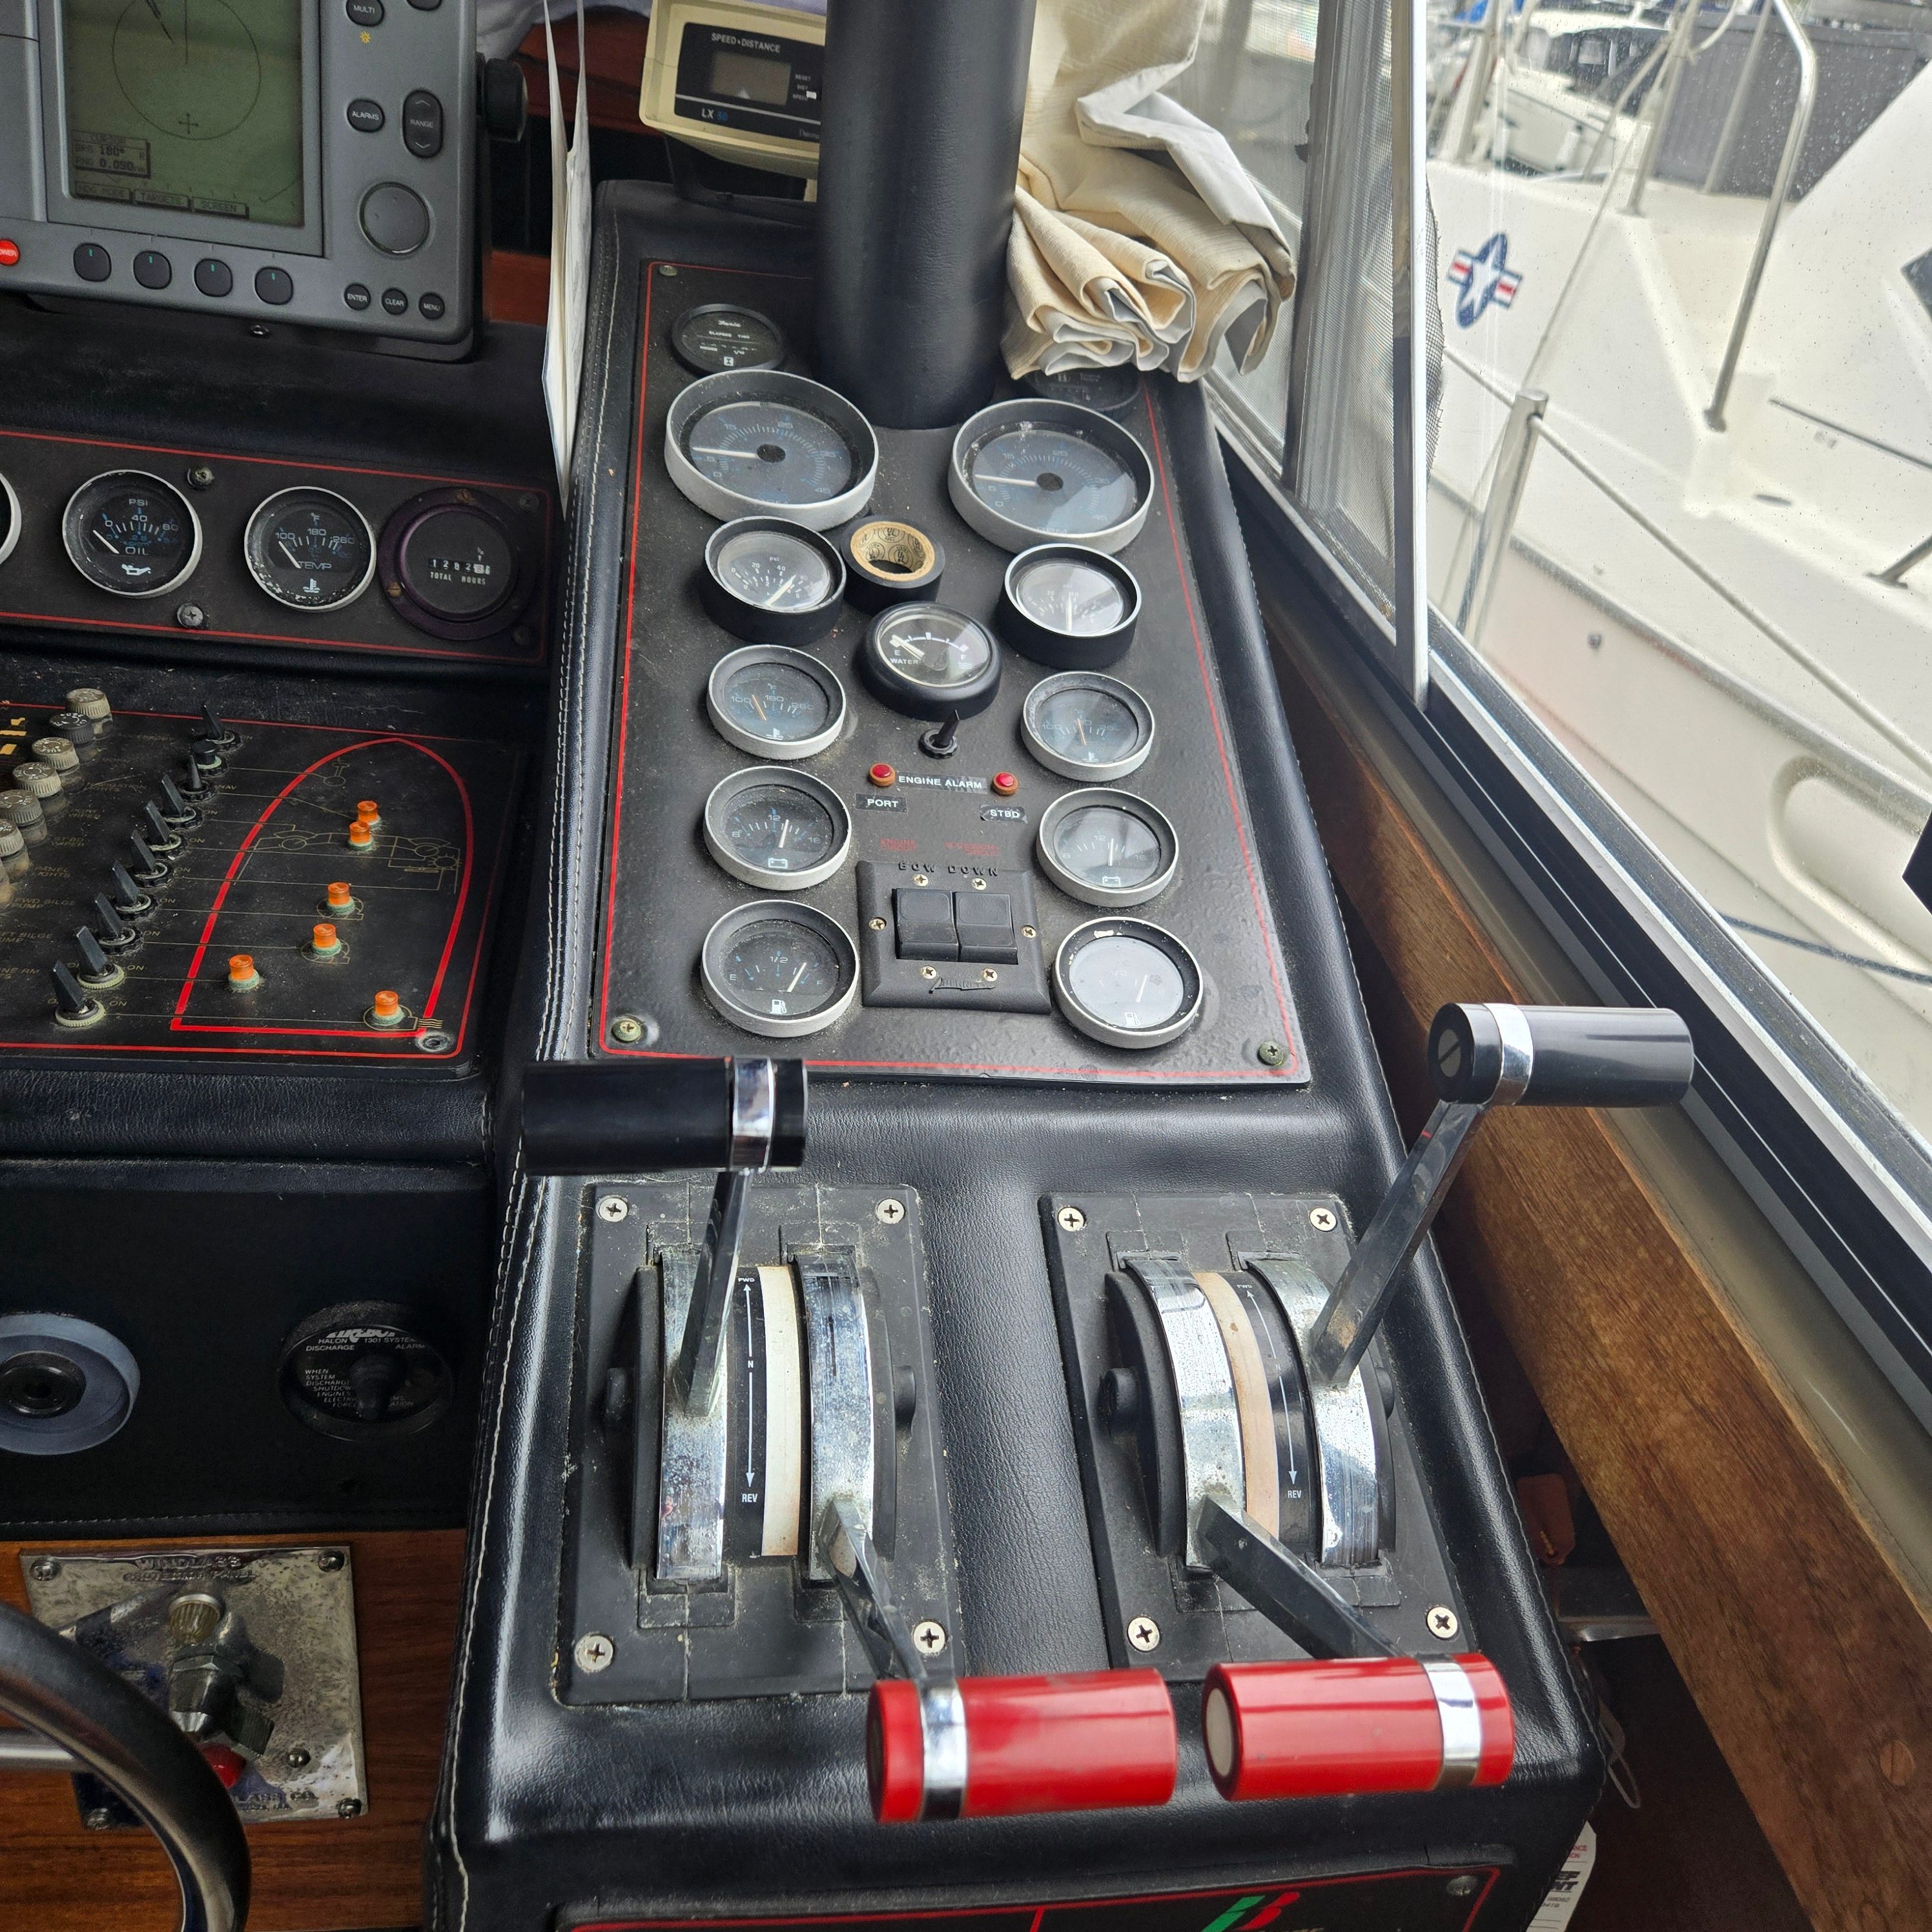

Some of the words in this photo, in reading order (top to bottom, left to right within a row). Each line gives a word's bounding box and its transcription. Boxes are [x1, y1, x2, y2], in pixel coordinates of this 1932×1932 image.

[353, 5, 375, 14] MULTI
[351, 110, 380, 121] ALARMS
[410, 118, 434, 129] RANGE
[347, 293, 367, 303] ENTER
[384, 298, 404, 307] CLEAR
[423, 302, 440, 311] MENU
[162, 523, 178, 531] 80
[307, 528, 327, 536] 180
[125, 546, 150, 556] OIL
[297, 560, 332, 570] TEMP
[430, 571, 452, 582] TOTAL
[461, 575, 486, 586] HOURS
[898, 776, 941, 786] ENGINE
[945, 779, 983, 789] ALARM
[867, 798, 899, 808] PORT
[990, 809, 1021, 819] STBD
[898, 861, 936, 873] BOW
[948, 865, 998, 876] DOWN
[747, 1360, 754, 1369] N
[742, 1493, 758, 1503] REV
[1287, 1490, 1302, 1499] REV
[134, 1556, 241, 1570] WINDLASS
